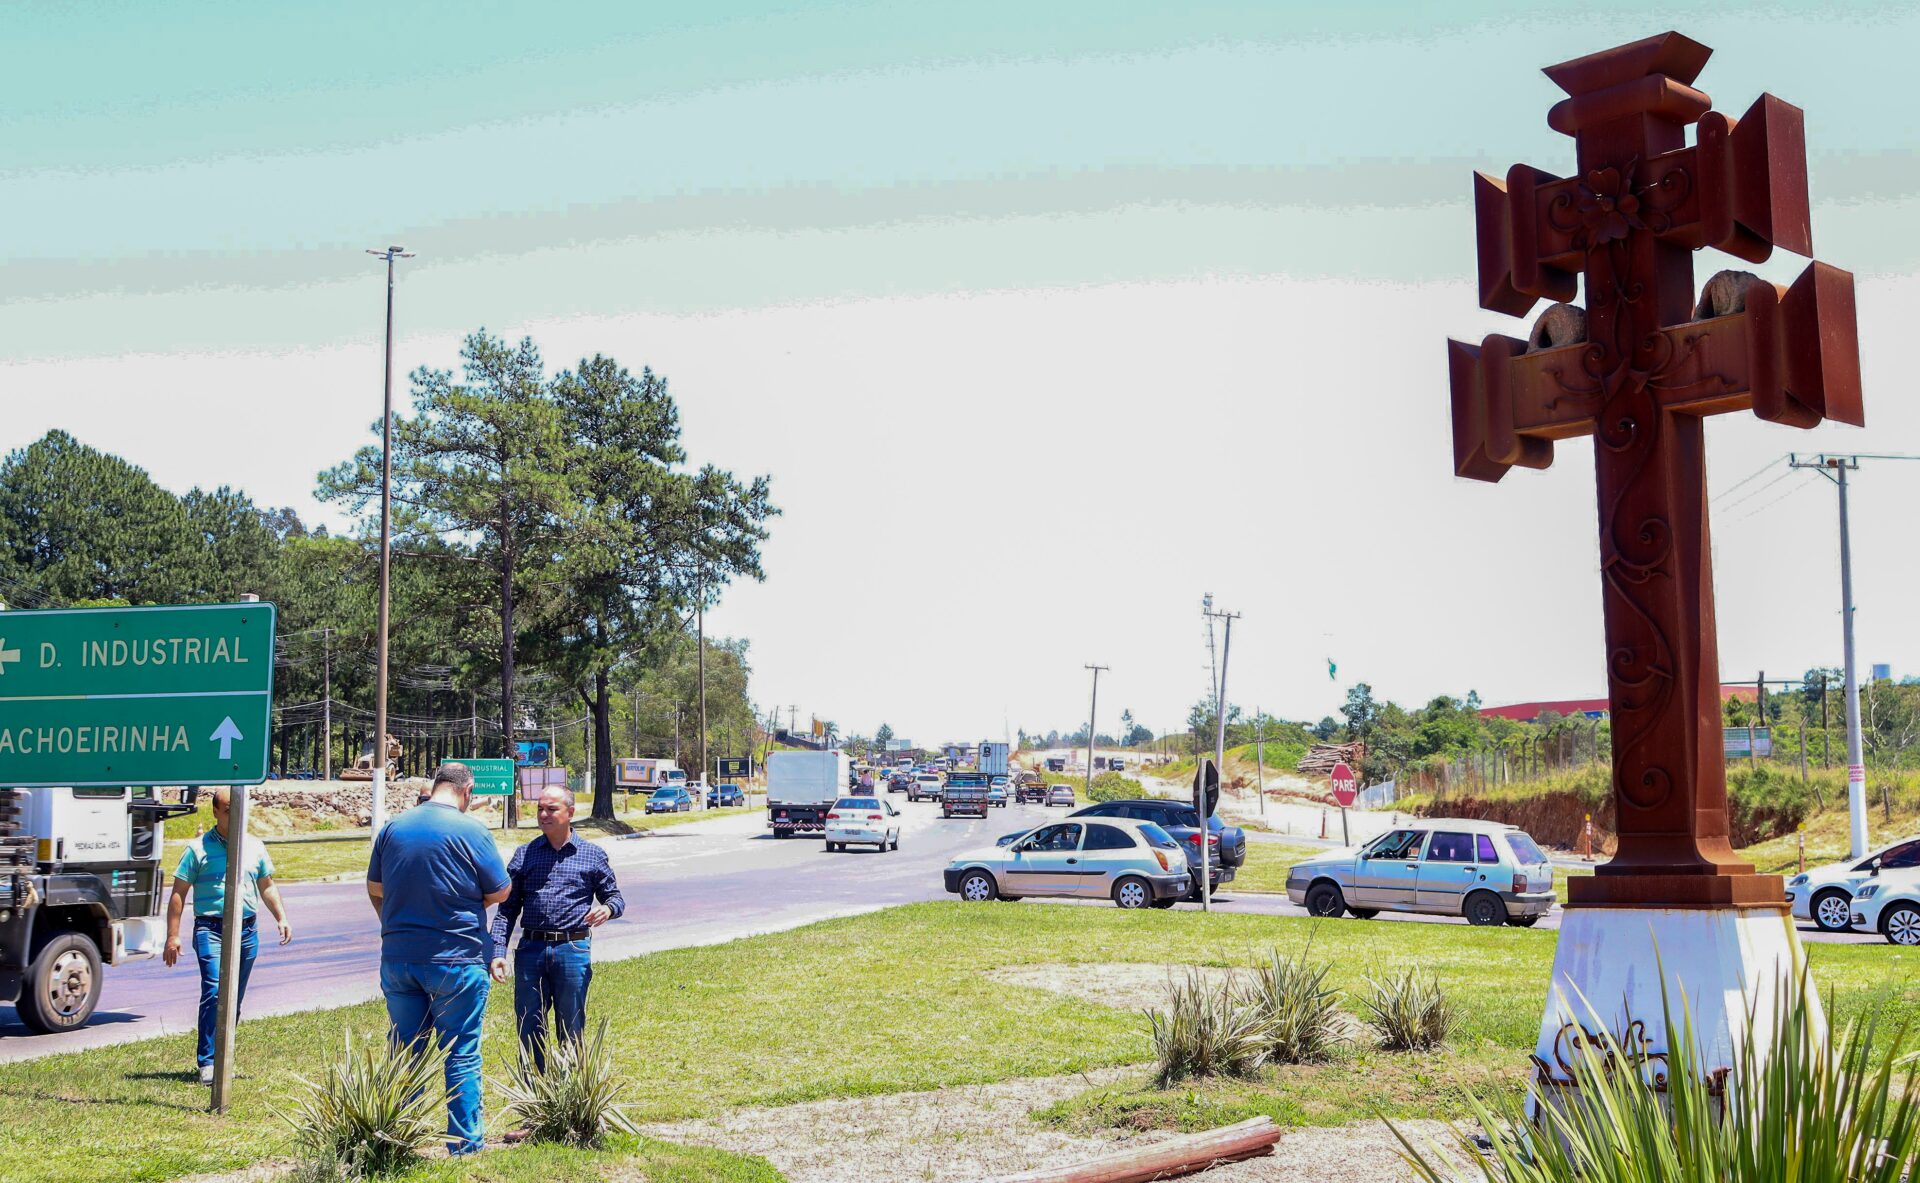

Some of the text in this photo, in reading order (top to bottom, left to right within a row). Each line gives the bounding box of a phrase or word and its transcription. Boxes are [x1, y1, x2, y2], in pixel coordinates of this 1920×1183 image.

[39, 637, 249, 669] D. INDUSTRIAL
[0, 725, 191, 754] ACHOEIRINHA
[1332, 778, 1355, 793] PARE
